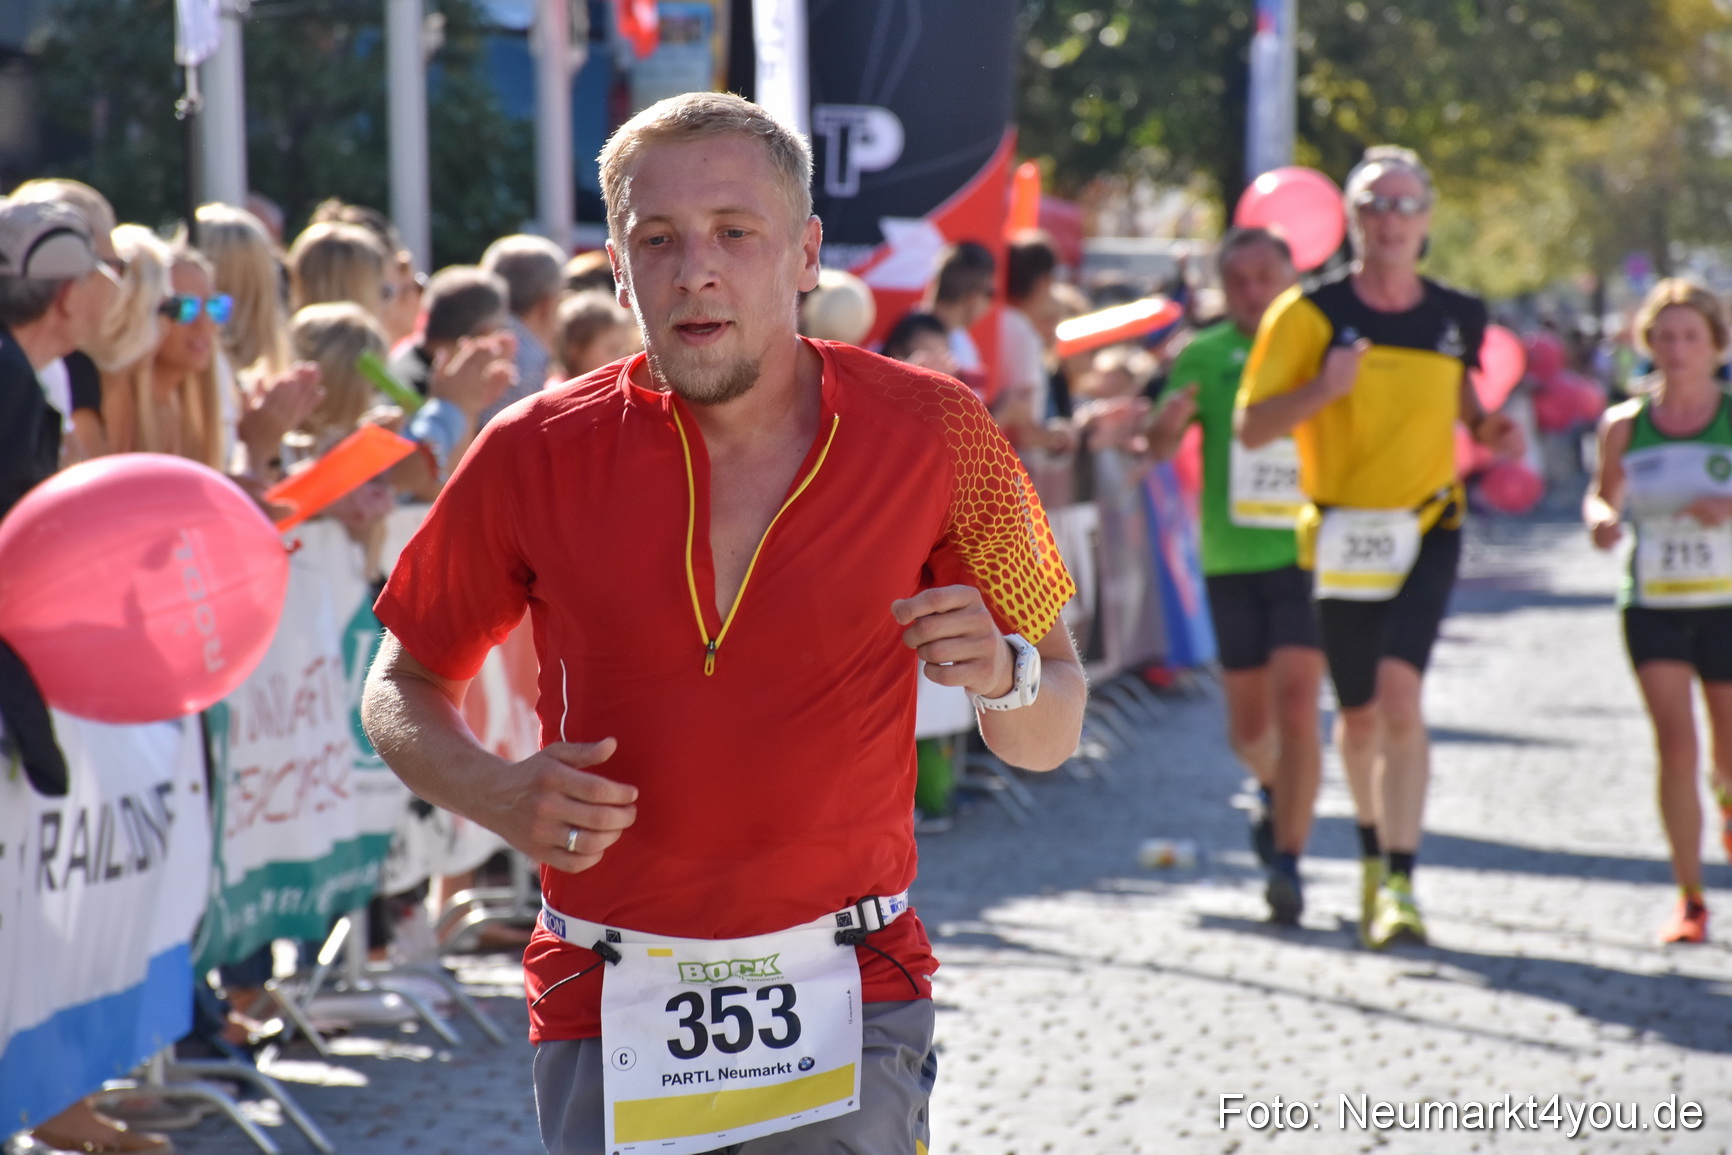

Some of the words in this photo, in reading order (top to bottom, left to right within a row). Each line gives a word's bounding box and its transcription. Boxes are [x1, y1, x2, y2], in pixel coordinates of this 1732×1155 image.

[678, 953, 782, 982] BOCK
[665, 983, 802, 1060] 353
[662, 1069, 714, 1086] PARTL
[718, 1062, 792, 1081] Neumarkt
